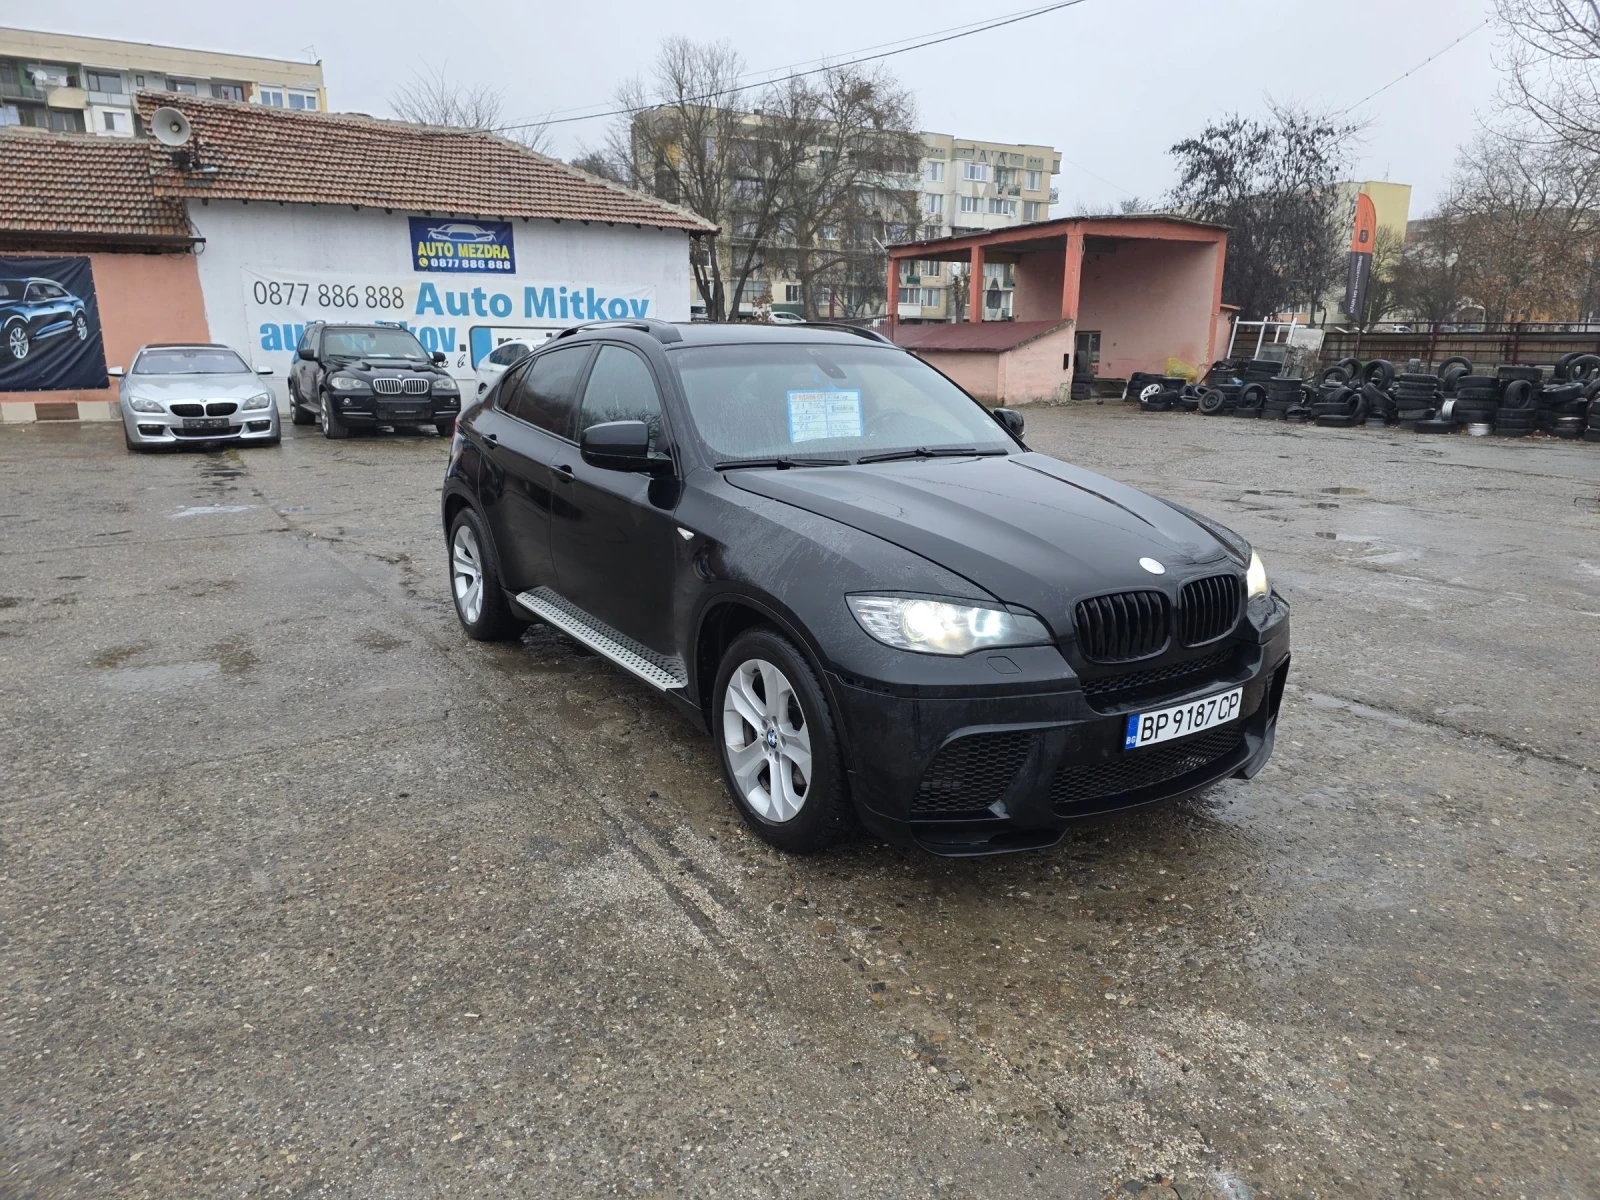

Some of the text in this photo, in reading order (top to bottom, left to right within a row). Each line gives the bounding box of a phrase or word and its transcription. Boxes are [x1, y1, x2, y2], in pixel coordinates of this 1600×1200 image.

[417, 241, 510, 259] AUTO MEZDRA
[430, 258, 511, 270] 0877 886 888
[253, 280, 405, 309] 0877 886 888
[415, 282, 650, 320] Auto Mitkov
[1140, 692, 1240, 742] BP 9187 CP
[1126, 735, 1136, 745] BG
